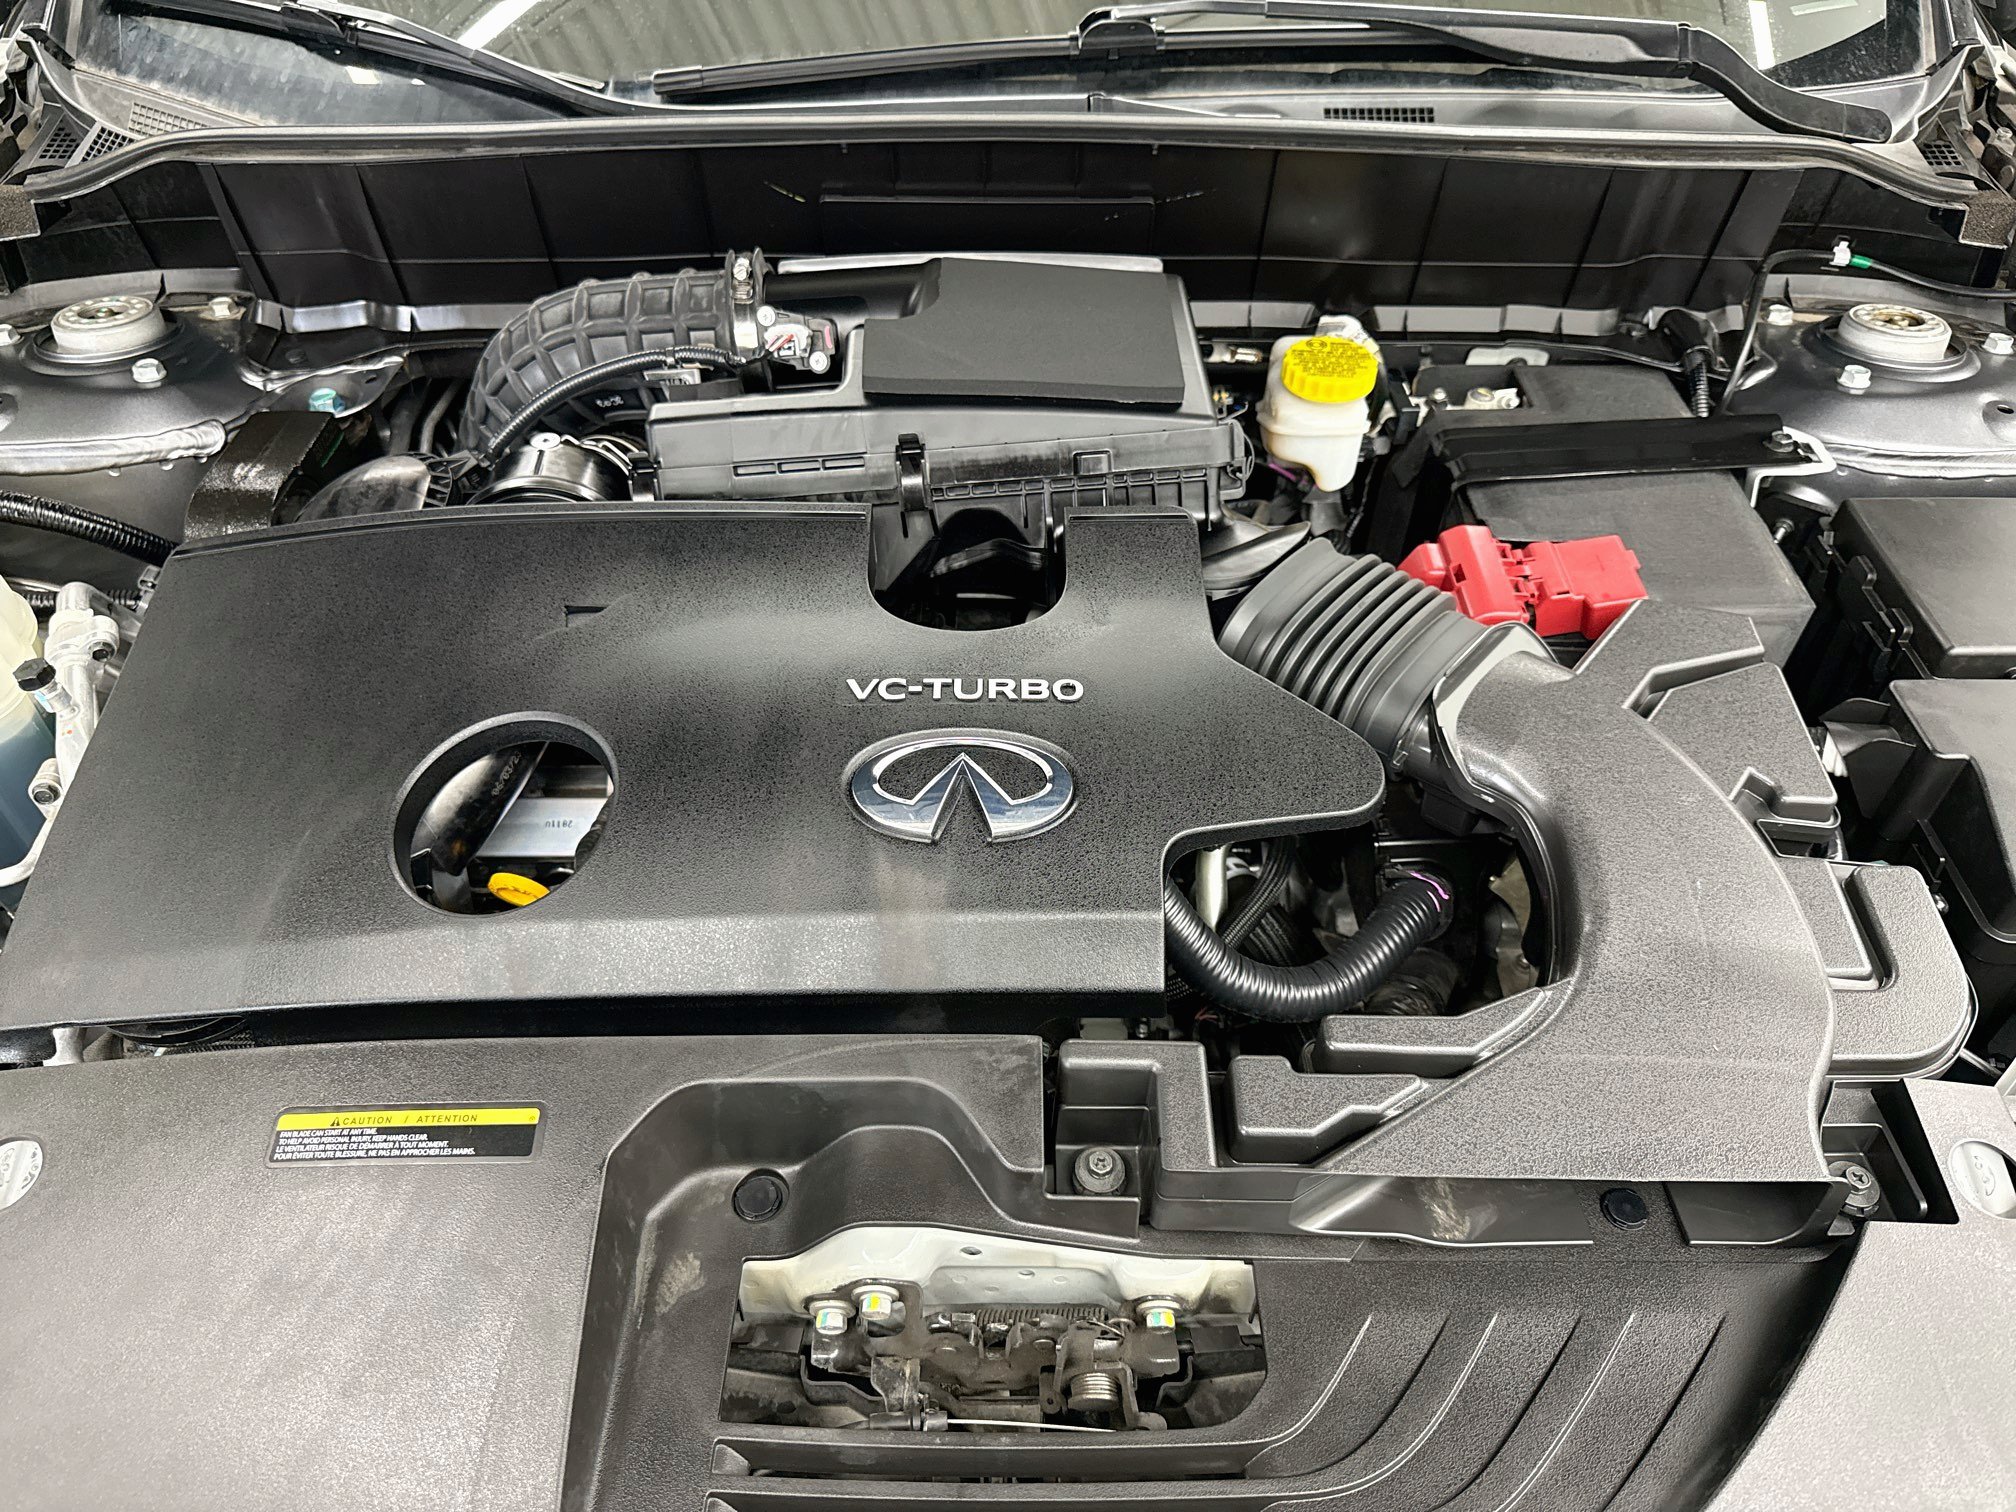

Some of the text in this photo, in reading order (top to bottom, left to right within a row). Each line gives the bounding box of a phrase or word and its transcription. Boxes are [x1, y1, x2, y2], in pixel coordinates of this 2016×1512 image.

[846, 678, 1084, 701] VC-TURBO
[343, 1114, 478, 1126] CAUTION / ATTENTION
[285, 1144, 326, 1152] VENTILATEUR
[359, 1141, 394, 1150] DÉMARRER
[394, 1140, 400, 1148] À
[321, 1136, 350, 1144] PERSONAL
[274, 1152, 292, 1160] POUR
[400, 1148, 440, 1156] APPROCHER
